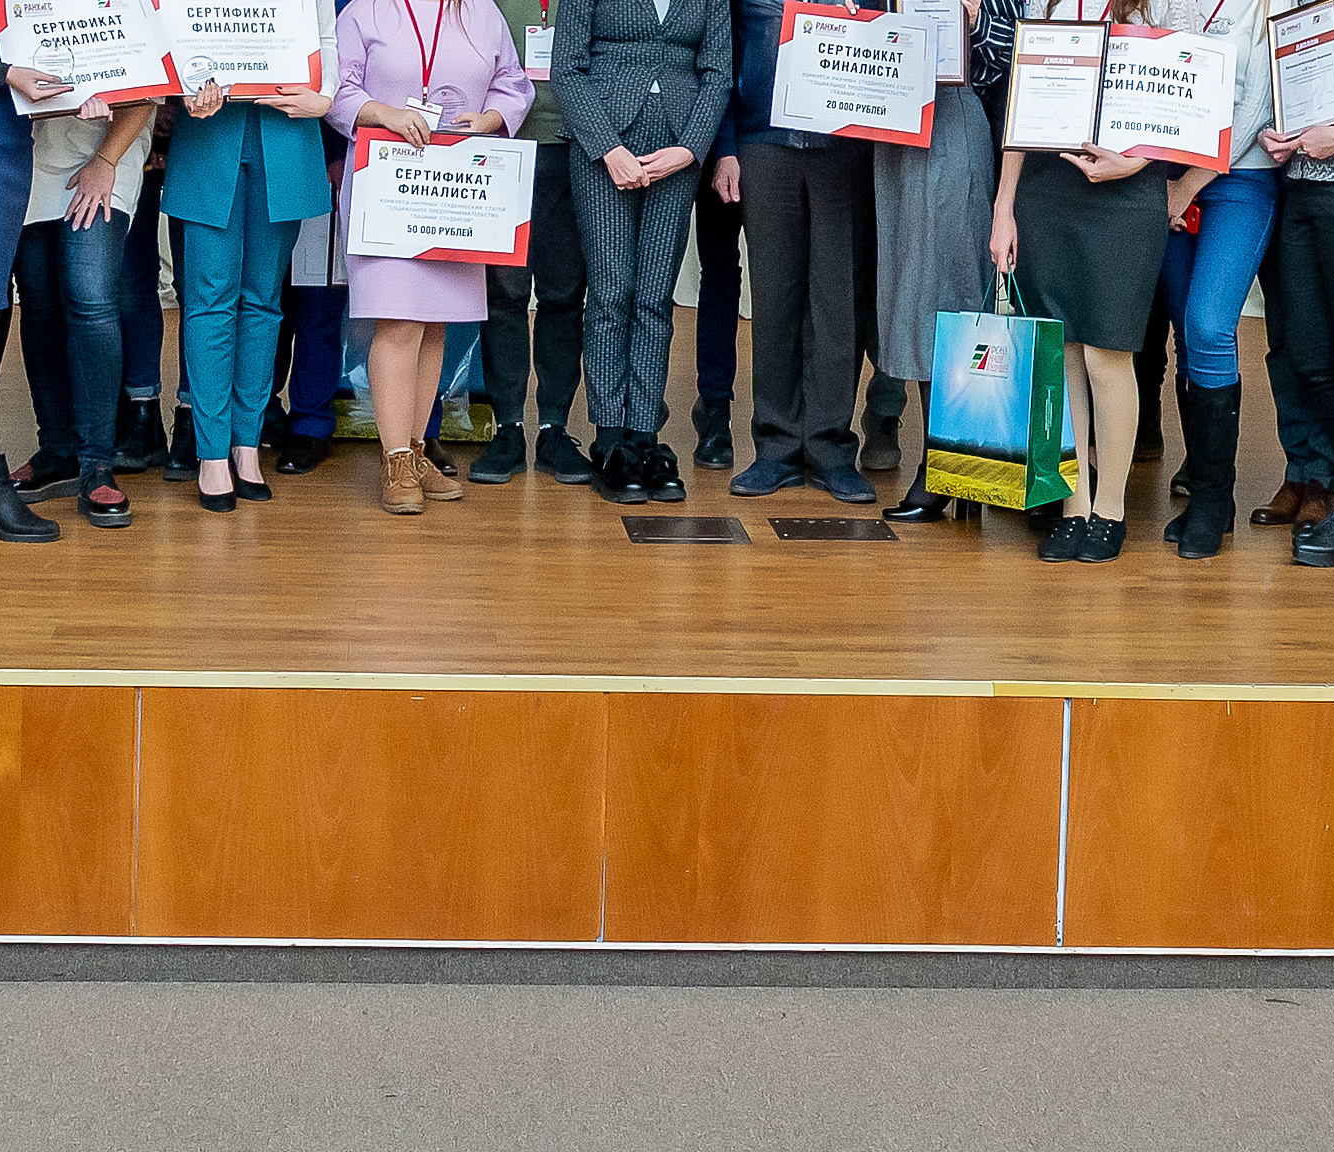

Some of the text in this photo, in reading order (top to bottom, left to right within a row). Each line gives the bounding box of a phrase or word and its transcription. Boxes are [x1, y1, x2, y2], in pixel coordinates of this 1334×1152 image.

[186, 7, 277, 18] СЕРТИФИКАТ
[33, 14, 123, 35] СЕРТИФИКАТ
[192, 22, 276, 33] ФИНАЛИСТА
[815, 21, 847, 34] РАНХиГС
[40, 29, 126, 48] ФИНАЛИСТА
[1108, 42, 1129, 51] ХиГС
[818, 42, 904, 64] СЕРТИФИКАТ
[94, 66, 127, 81] РУБЛЕЙ
[219, 61, 235, 71] 000
[237, 60, 269, 71] РУБЛЕЙ
[819, 58, 899, 79] ФИНАЛИСТА
[1105, 62, 1198, 84] ЕРТИФИКАТ
[1103, 79, 1193, 100] ФИНАЛИСТА
[825, 99, 887, 116] 20 000 РУБЛЕЙ
[1110, 120, 1180, 136] 20 000 РУБЛЕЙ
[391, 147, 425, 158] РАНХиГС
[395, 167, 493, 186] СЕРТИФИКАТ
[398, 183, 487, 201] ФИНАЛИСТА
[406, 224, 473, 237] 50 000 РУБЛЕЙ
